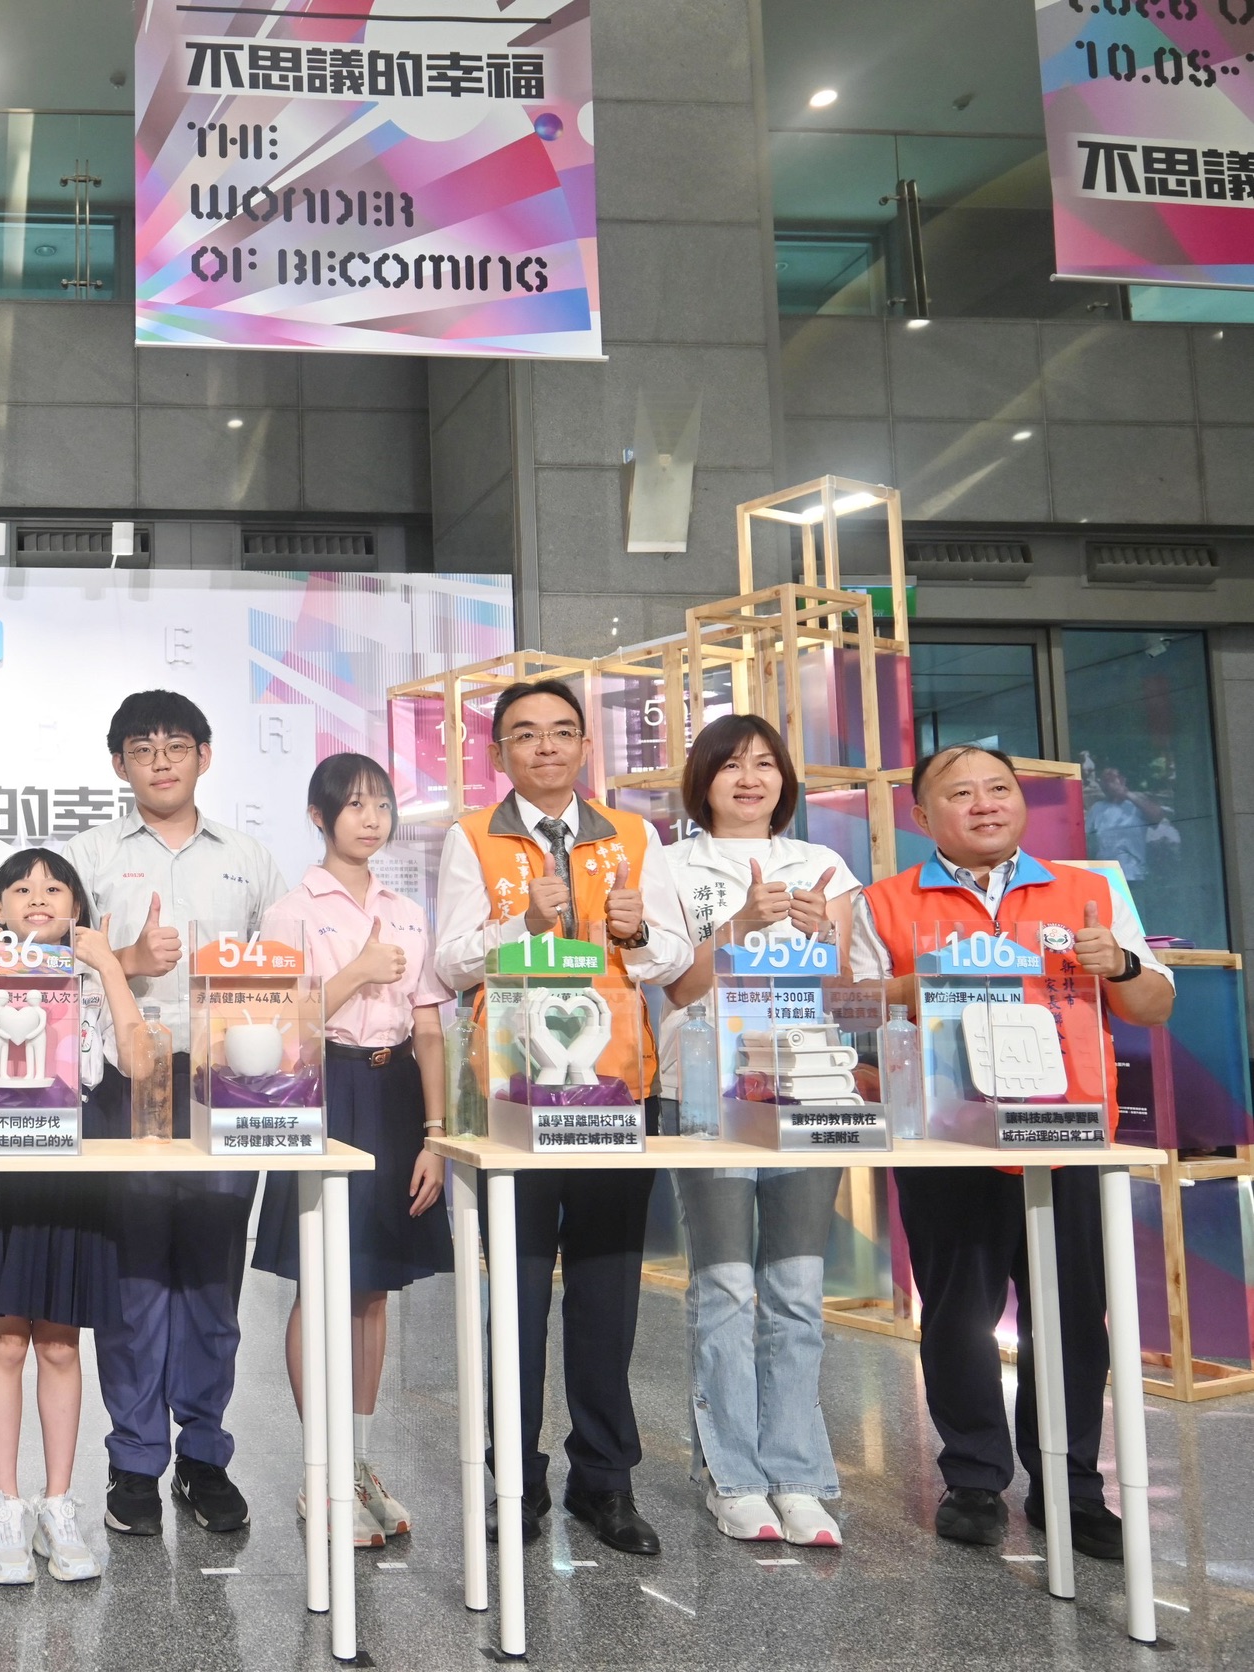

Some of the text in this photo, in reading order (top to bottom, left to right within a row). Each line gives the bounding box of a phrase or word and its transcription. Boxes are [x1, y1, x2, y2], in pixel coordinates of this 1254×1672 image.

[186, 41, 545, 99] 不思議的幸福
[187, 121, 278, 160] THE
[191, 183, 414, 227] WONDER
[191, 245, 548, 292] OF BECOMING
[715, 882, 728, 907] 理事長
[218, 931, 296, 968] 54 億元
[517, 931, 598, 968] 11 萬課程
[744, 931, 827, 968] 95%
[945, 931, 1015, 968] 1.06
[1016, 956, 1040, 968] 萬班
[46, 956, 72, 968] 億元
[1060, 958, 1077, 1009] 新北市
[767, 1007, 816, 1019] 教育創新
[236, 1116, 299, 1129] 讓每個孩子
[538, 1114, 637, 1128] 讓學習離開校門後
[791, 1113, 877, 1126] 讓好的教育就在
[1005, 1111, 1099, 1124] 讓科技成為學習與
[224, 1134, 312, 1148] 吃得健康又營養
[538, 1132, 638, 1146] 仍持續在城市發生
[811, 1131, 860, 1144] 生活附近
[1002, 1130, 1105, 1142] 城市治理的日常工具
